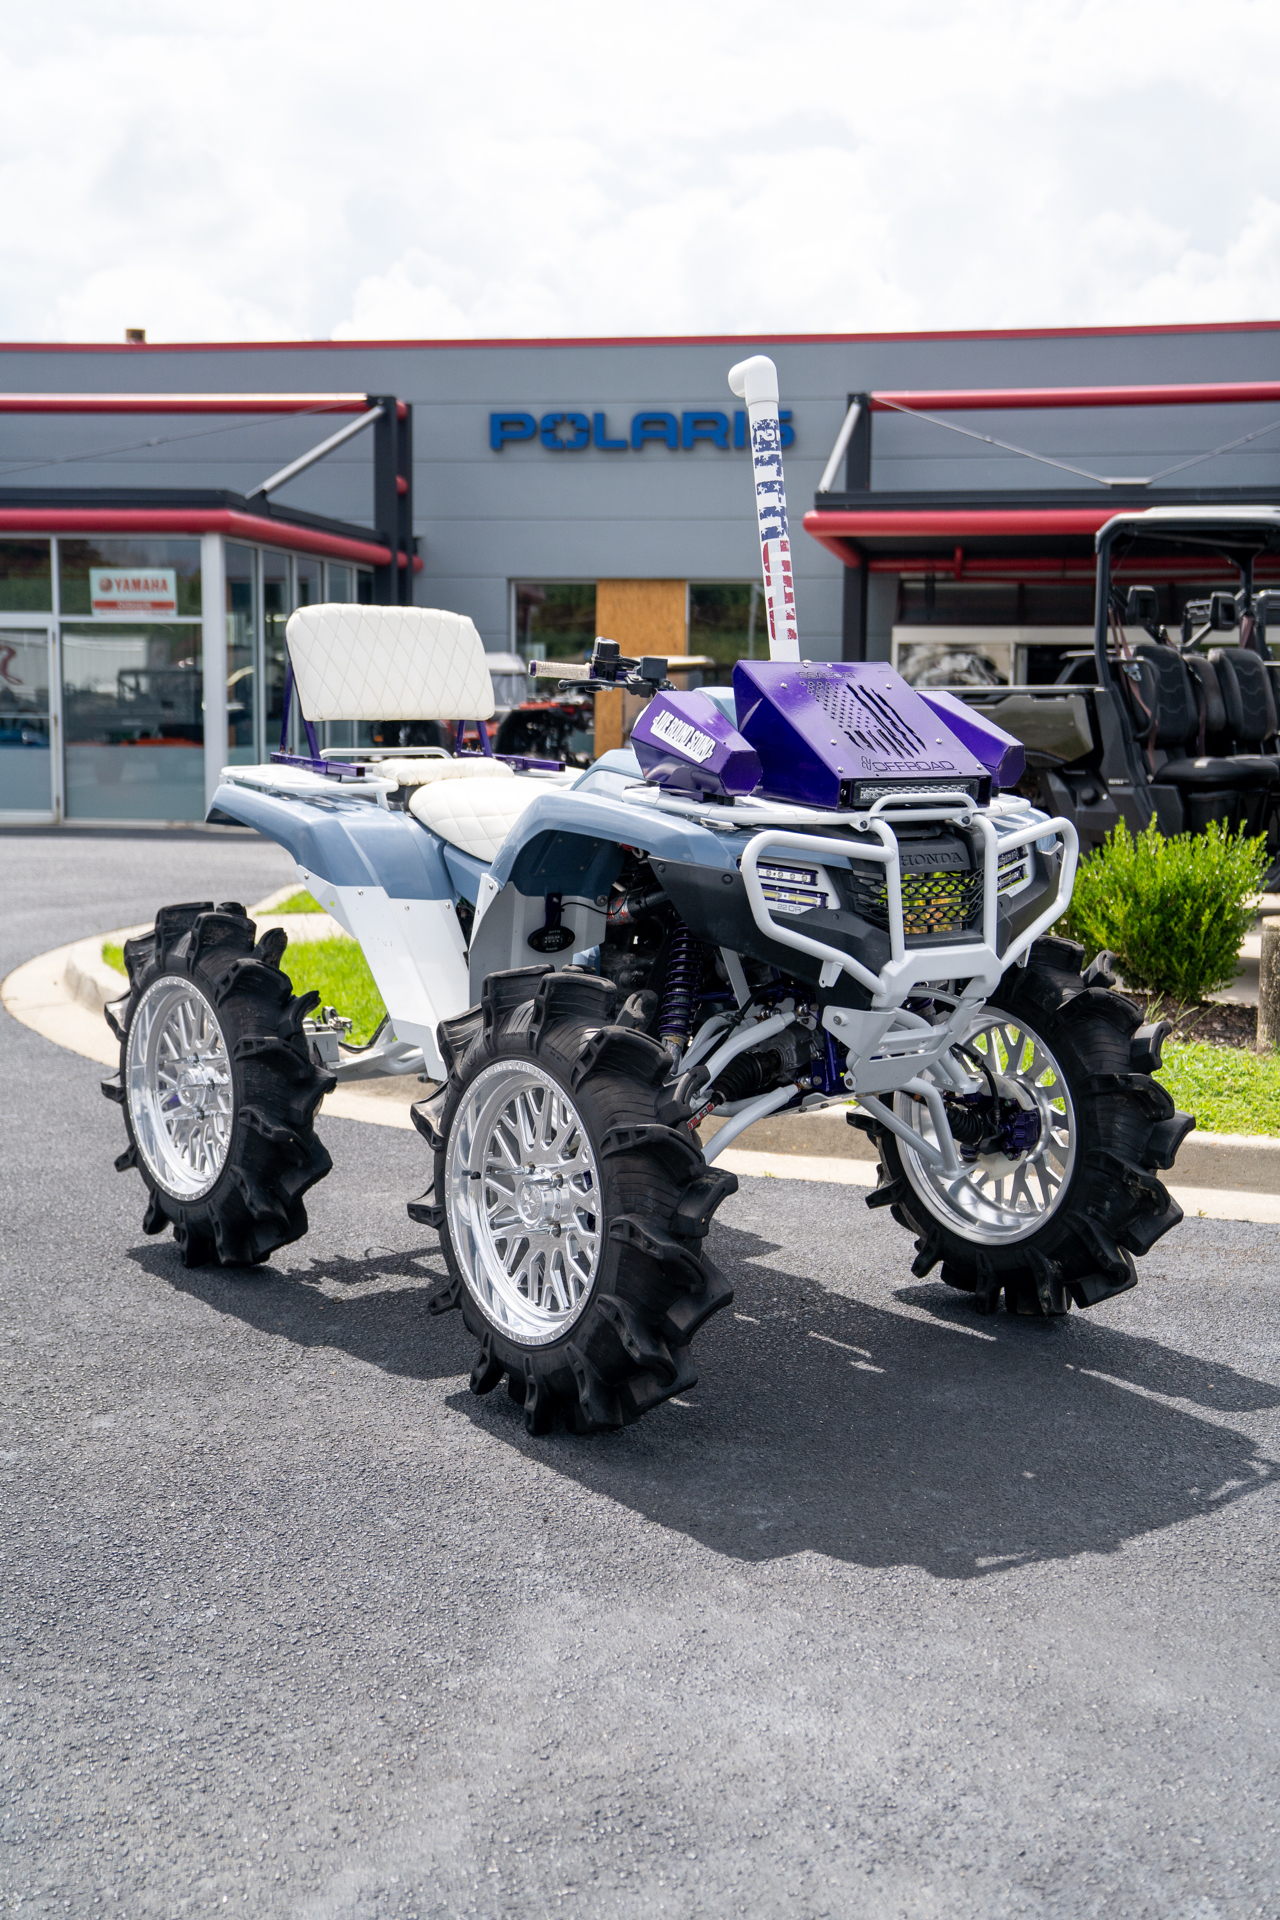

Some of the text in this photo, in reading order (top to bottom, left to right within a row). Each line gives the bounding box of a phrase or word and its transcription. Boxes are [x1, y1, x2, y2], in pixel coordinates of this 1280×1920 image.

[114, 578, 168, 593] YAMAHA
[653, 709, 717, 758] LIVE ROUND SOUND
[872, 760, 957, 772] OFFROAD
[899, 852, 965, 866] HONDA
